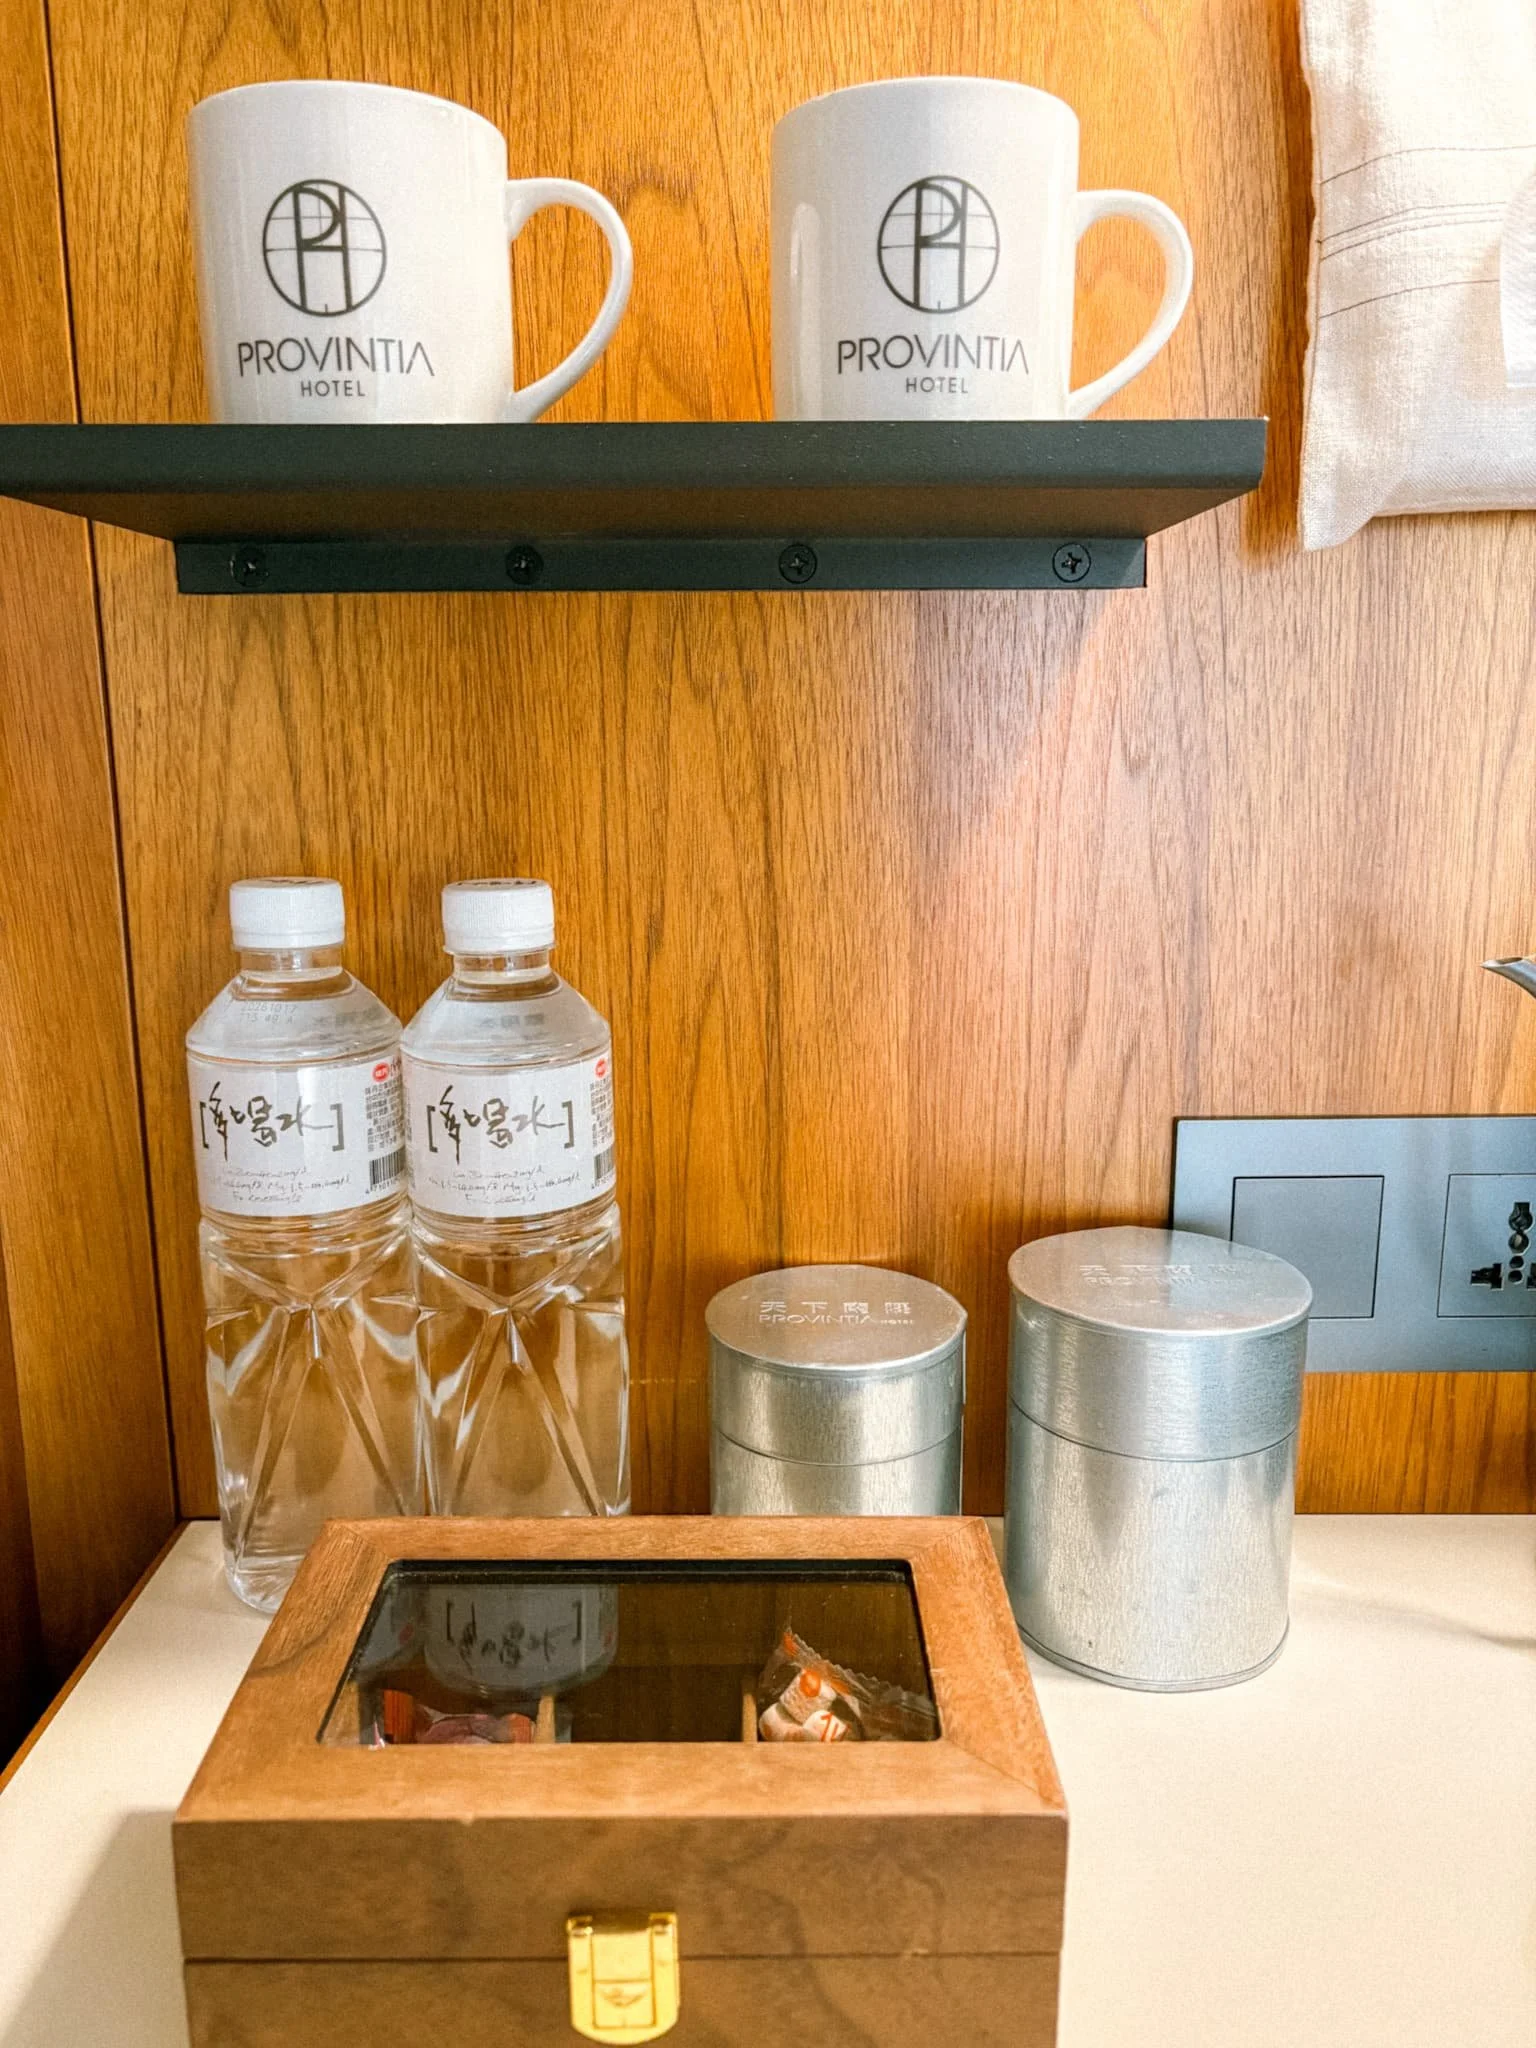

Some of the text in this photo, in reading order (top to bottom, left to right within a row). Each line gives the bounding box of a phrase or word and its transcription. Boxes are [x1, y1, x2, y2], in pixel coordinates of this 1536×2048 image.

[238, 336, 435, 378] PROVINTIA
[837, 333, 1030, 375] PROVINTIA
[300, 380, 366, 398] HOTEL
[905, 376, 969, 394] HOTEL
[759, 1314, 875, 1325] PROVINTIA
